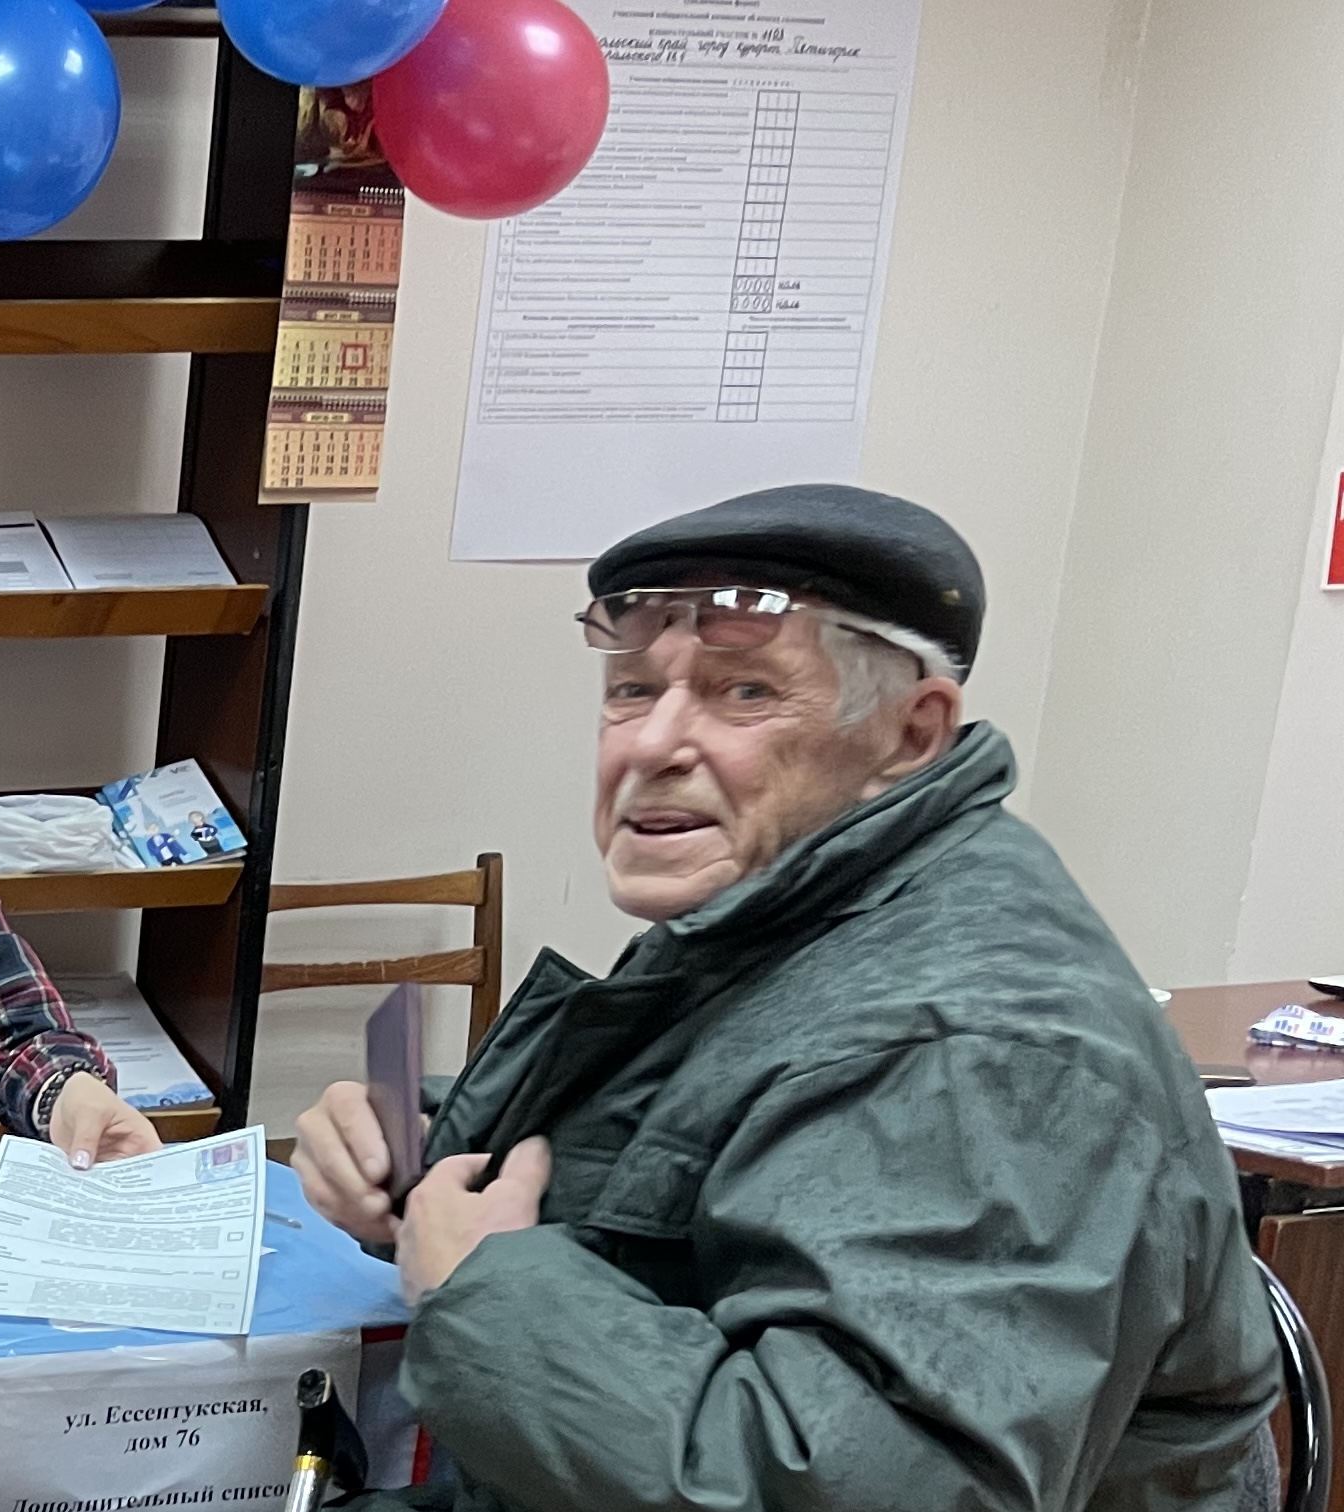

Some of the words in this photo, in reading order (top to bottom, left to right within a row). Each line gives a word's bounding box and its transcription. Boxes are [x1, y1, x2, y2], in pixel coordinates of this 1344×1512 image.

[64, 1414, 97, 1434] ул.
[105, 1398, 269, 1425] Ессентукская,
[124, 1435, 168, 1453] дом
[176, 1427, 201, 1448] 76
[221, 1482, 293, 1502] списо
